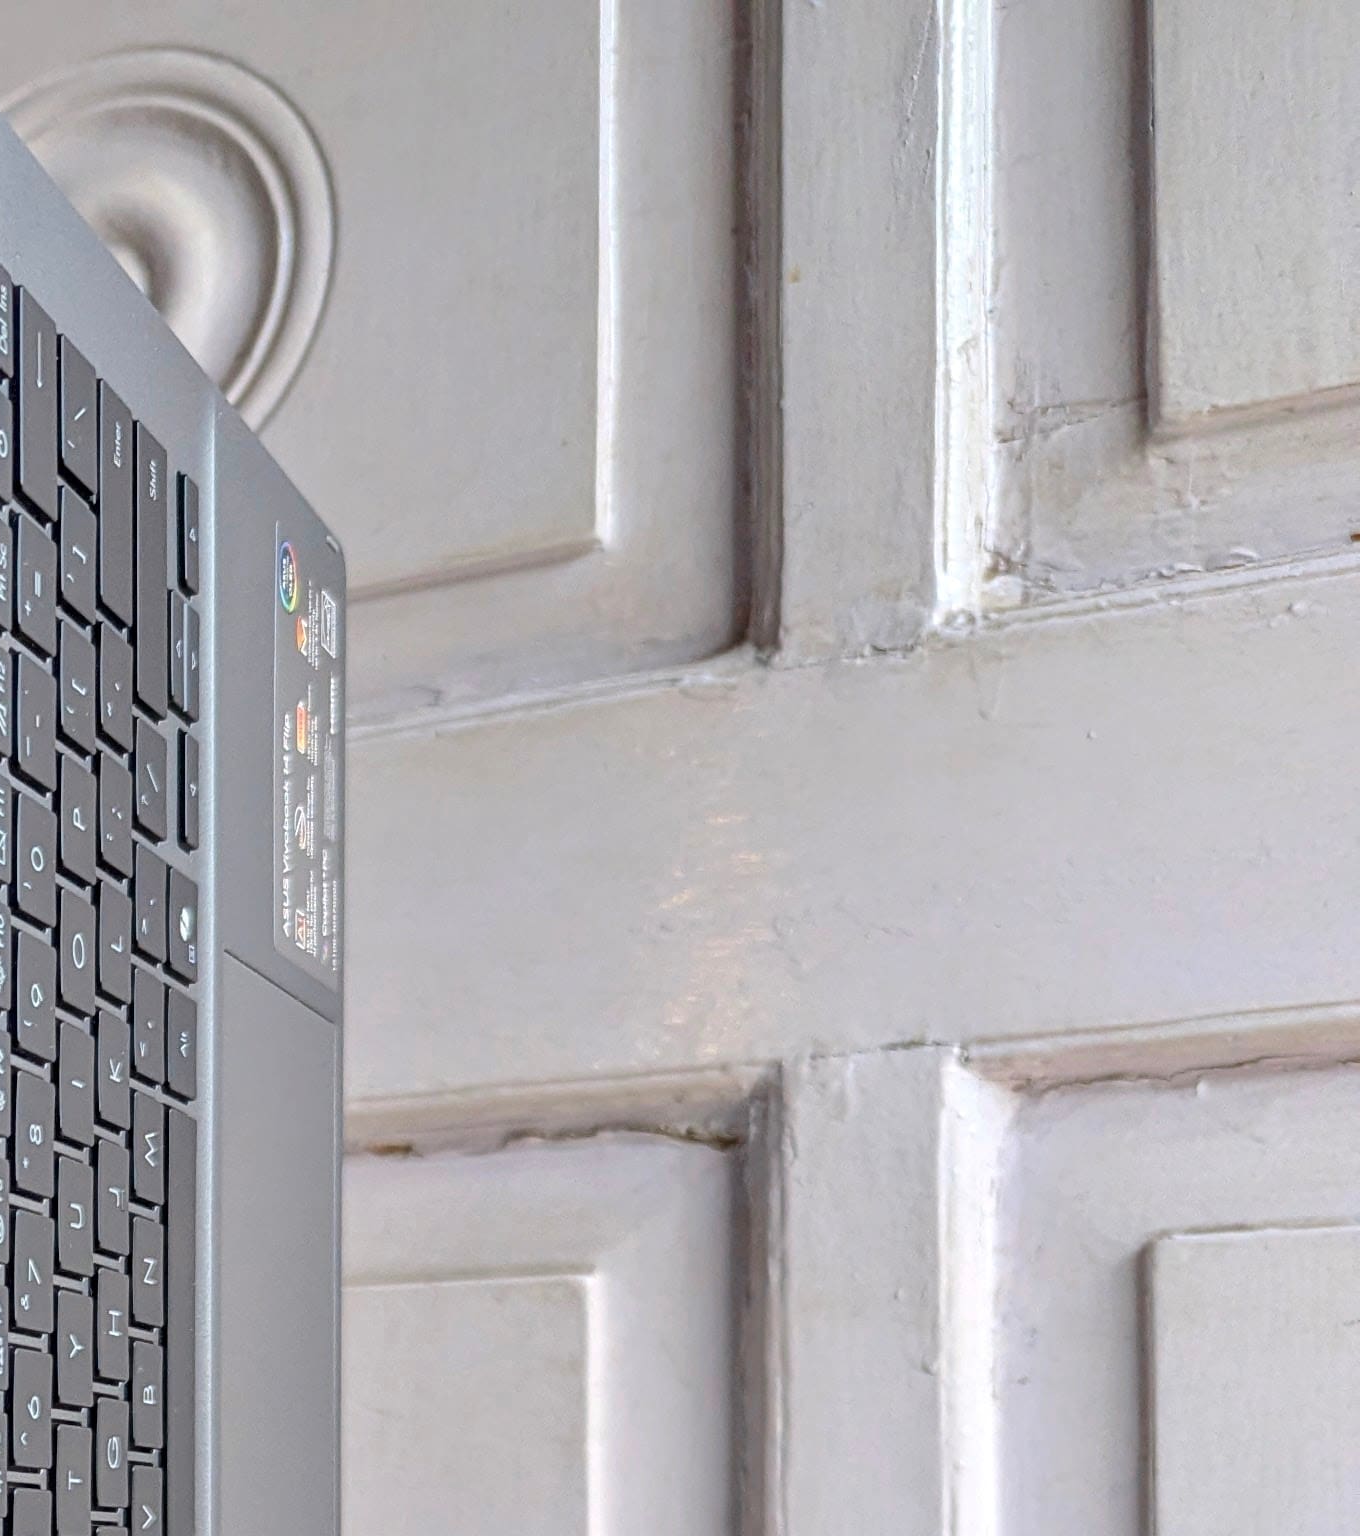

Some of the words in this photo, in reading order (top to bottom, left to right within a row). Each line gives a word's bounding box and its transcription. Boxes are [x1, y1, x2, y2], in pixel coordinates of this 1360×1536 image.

[113, 421, 122, 468] Enter
[149, 459, 157, 501] Shift
[72, 807, 86, 831] P
[282, 780, 290, 873] Vivobook
[282, 878, 290, 937] ASUS
[110, 936, 123, 953] L
[31, 983, 43, 1008] 9
[109, 1059, 121, 1083] K
[30, 1124, 42, 1145] 8
[144, 1132, 159, 1167] M
[70, 1203, 84, 1229] U
[28, 1258, 41, 1285] 7
[108, 1310, 123, 1337] H
[69, 1334, 84, 1358] Y
[27, 1396, 40, 1419] 6
[143, 1385, 157, 1405] B
[107, 1436, 120, 1469] G
[68, 1470, 83, 1491] T
[142, 1505, 156, 1529] V
